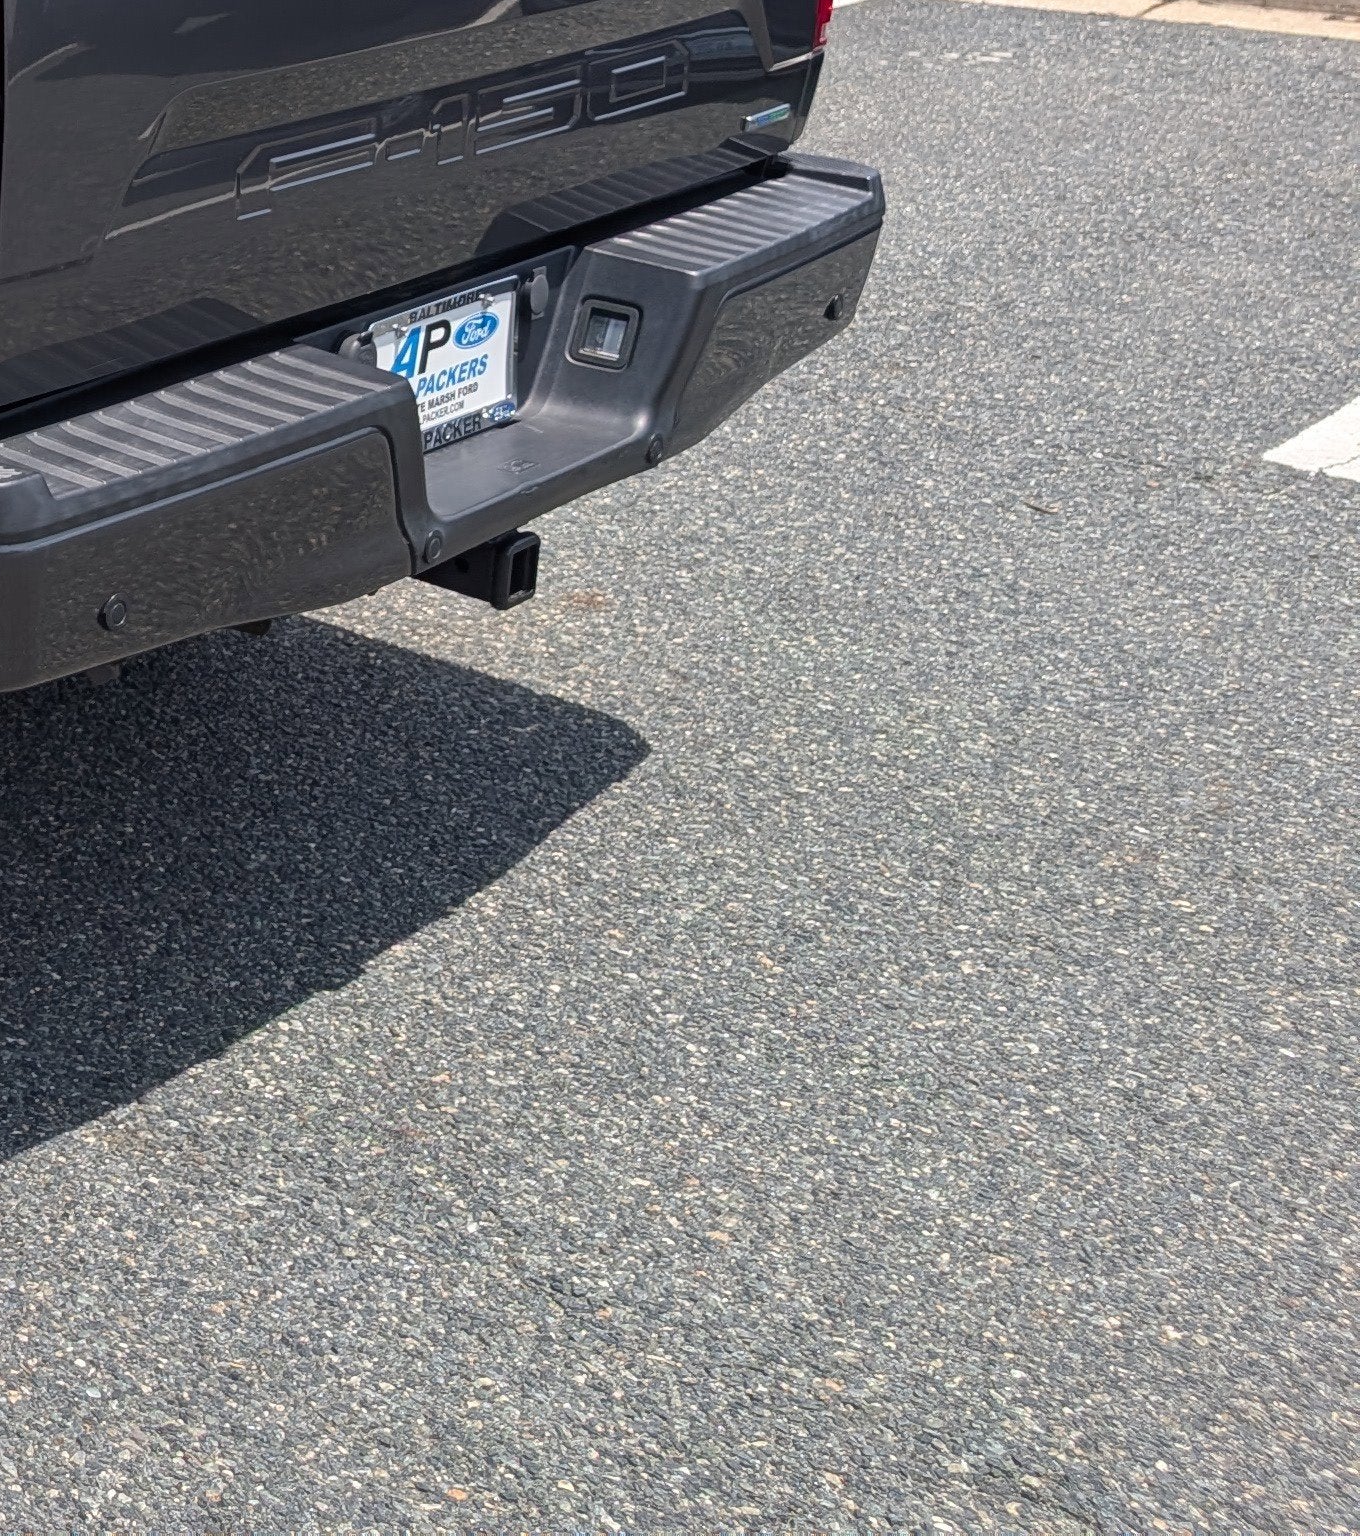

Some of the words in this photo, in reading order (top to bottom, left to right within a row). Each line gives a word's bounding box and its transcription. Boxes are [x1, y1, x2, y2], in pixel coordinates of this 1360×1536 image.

[409, 291, 481, 324] BALTIMORE
[462, 317, 491, 345] Ford
[391, 319, 451, 378] AP
[416, 353, 488, 398] PACKERS
[428, 390, 456, 409] MARSH
[457, 381, 478, 399] FORD
[424, 416, 481, 449] PACKER
